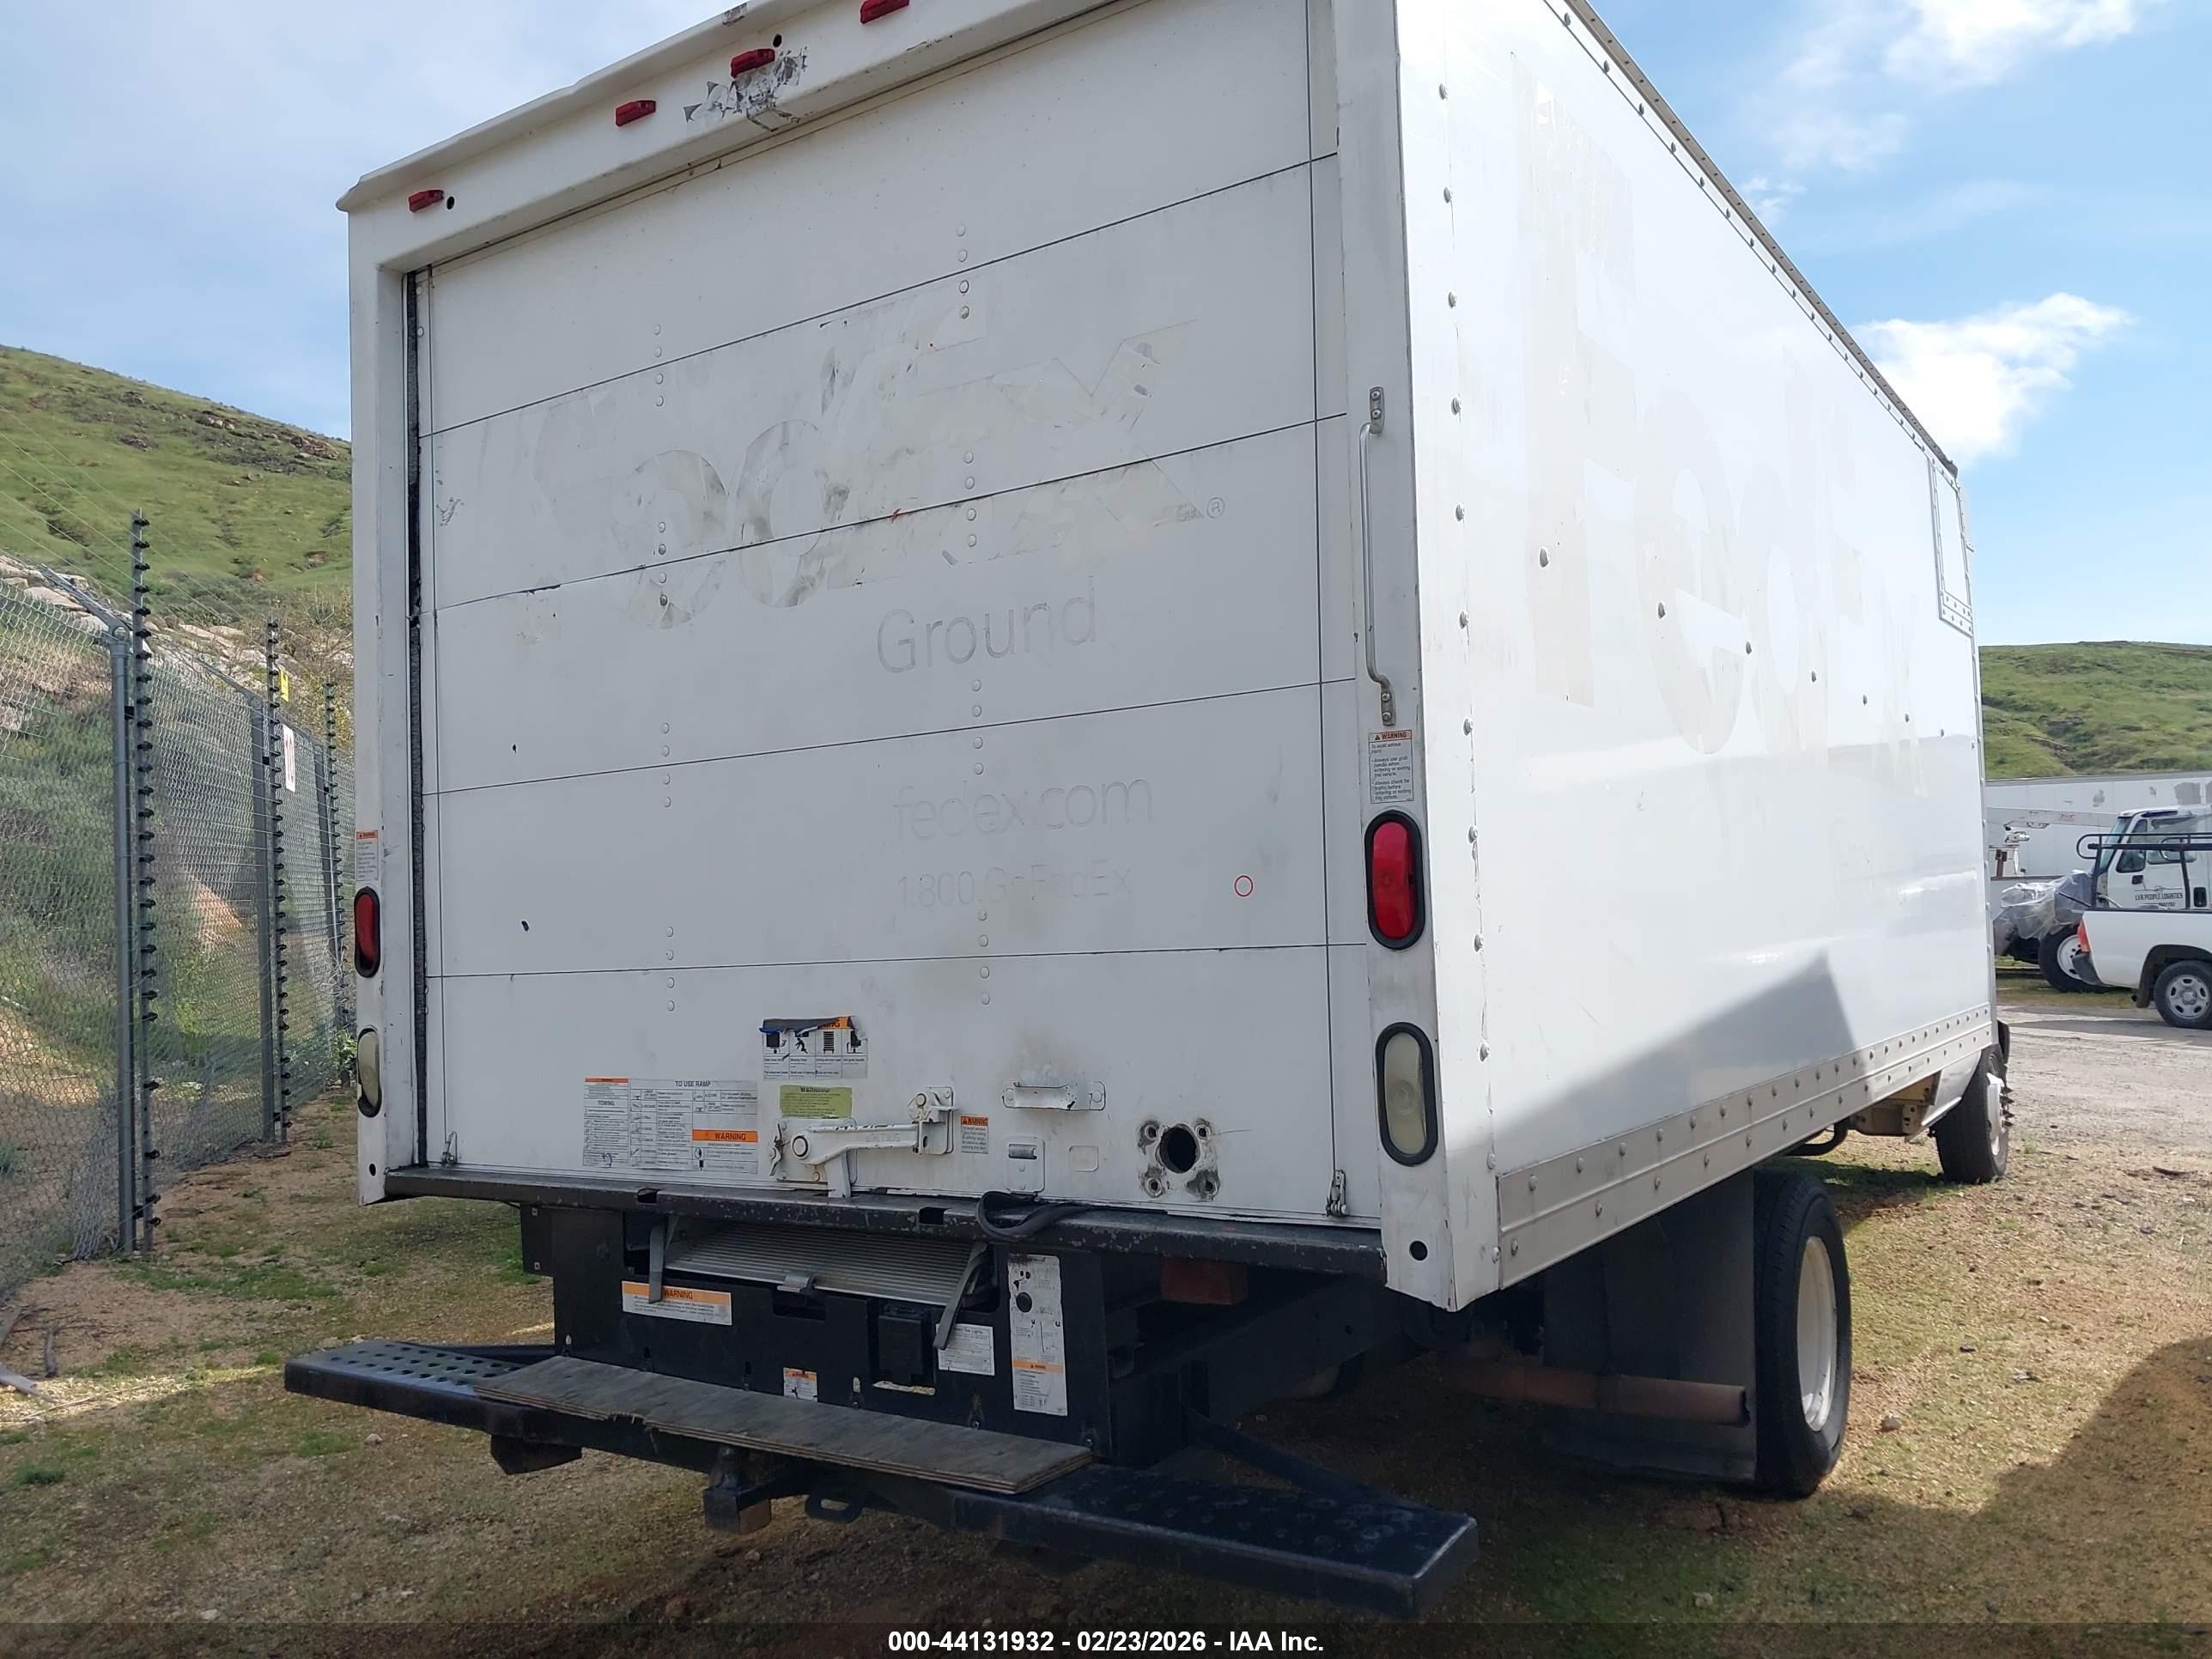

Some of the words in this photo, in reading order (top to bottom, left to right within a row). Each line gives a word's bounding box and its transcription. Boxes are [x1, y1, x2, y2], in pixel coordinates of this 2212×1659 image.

[877, 576, 1097, 673] Ground
[893, 779, 1153, 840] fedex.com
[664, 1290, 693, 1299] WARNING
